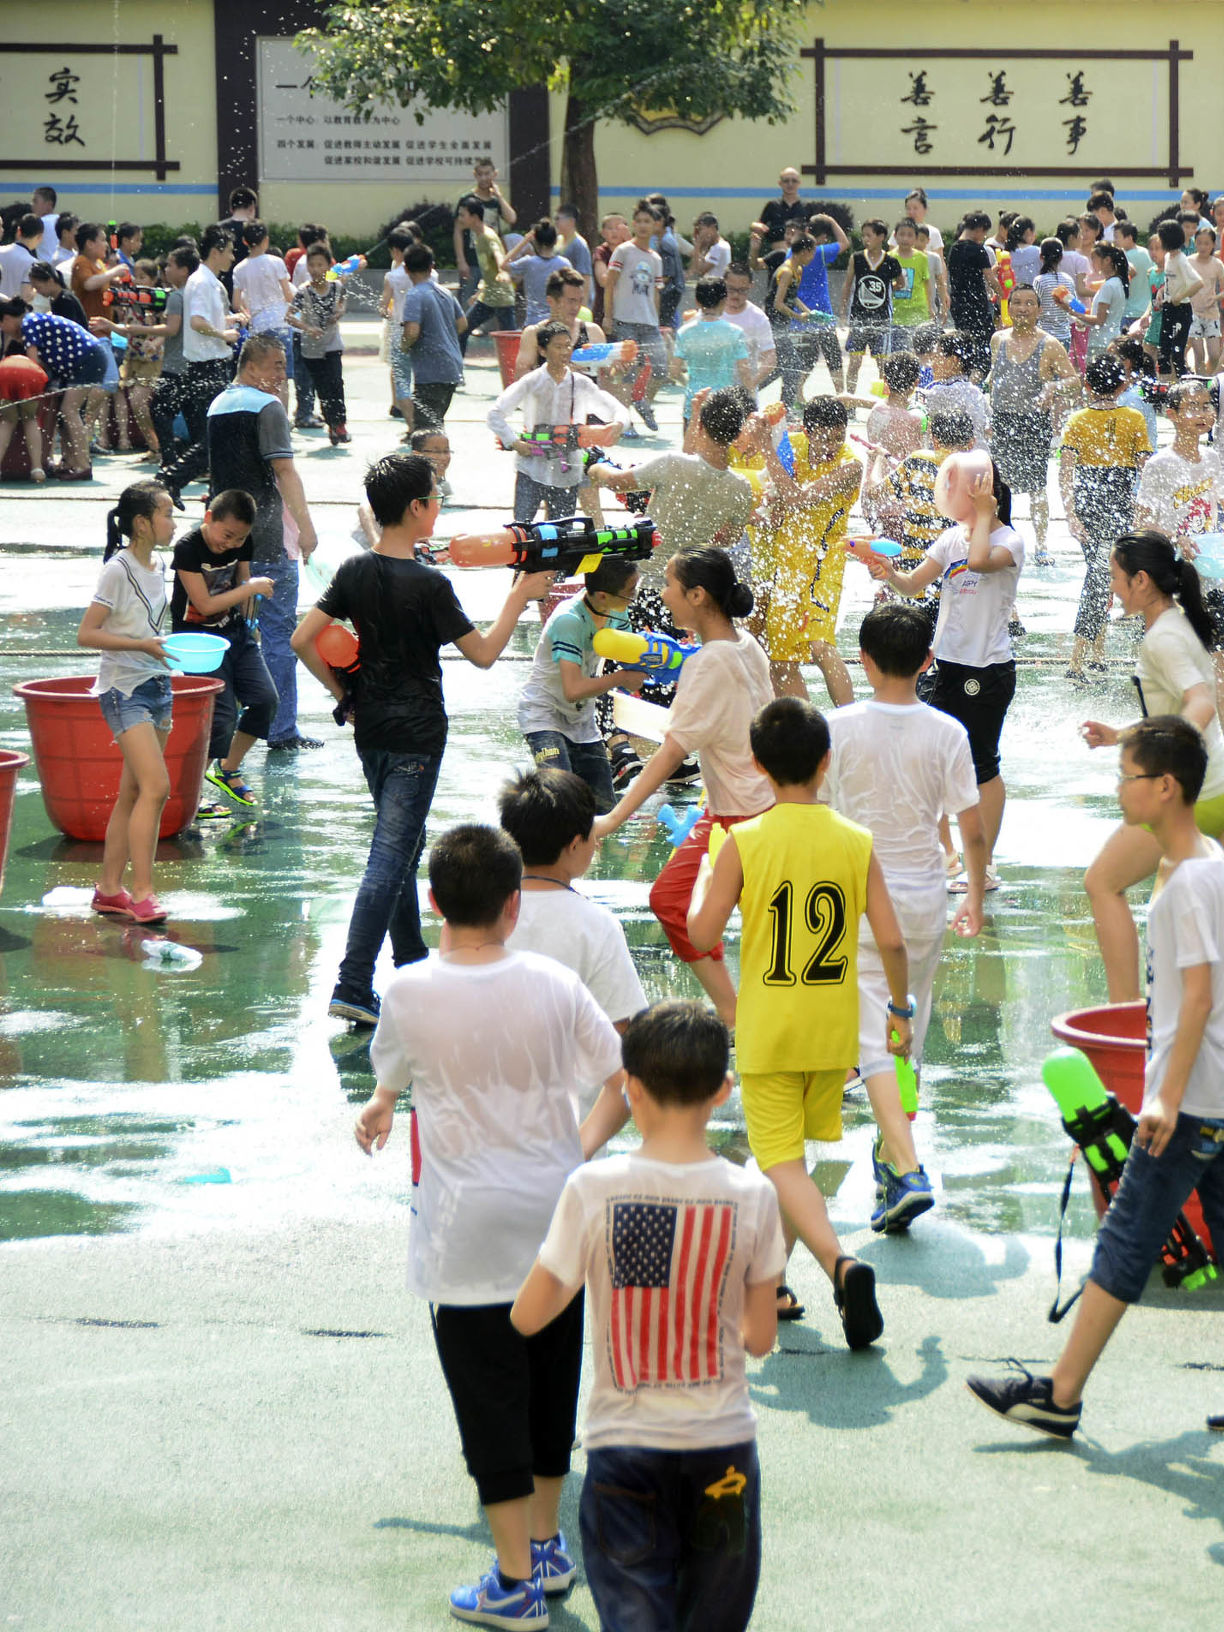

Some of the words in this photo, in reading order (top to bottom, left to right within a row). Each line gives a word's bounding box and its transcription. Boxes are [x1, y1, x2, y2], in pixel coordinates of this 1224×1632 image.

[44, 67, 86, 147] 实效
[900, 70, 937, 155] 善言
[978, 70, 1016, 155] 善行
[1059, 70, 1093, 155] 善事
[868, 280, 882, 293] 35
[763, 880, 848, 987] 12
